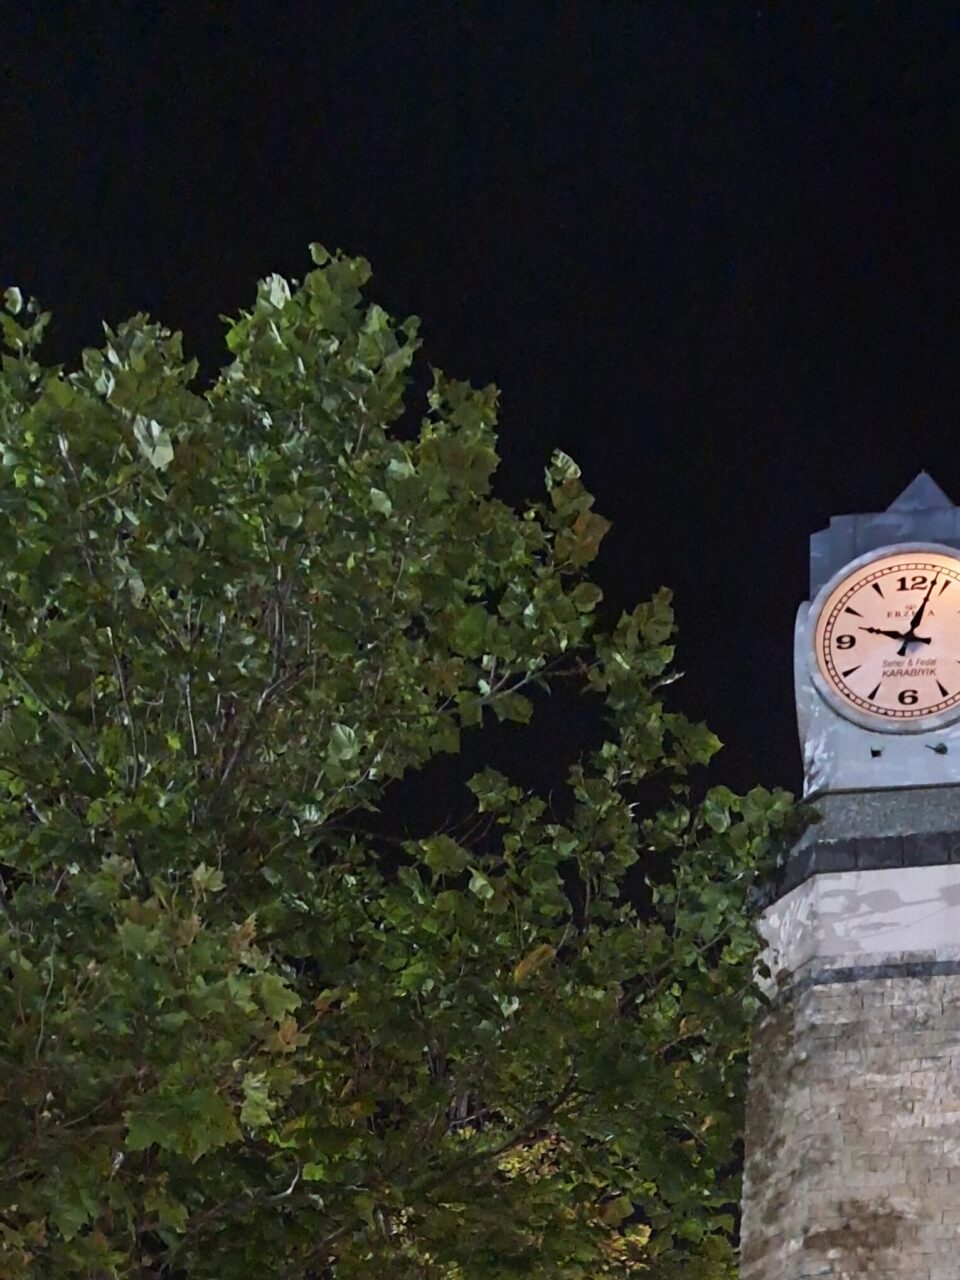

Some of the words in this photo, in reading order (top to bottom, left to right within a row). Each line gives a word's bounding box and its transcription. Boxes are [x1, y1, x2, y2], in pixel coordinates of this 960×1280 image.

[896, 576, 929, 591] 12
[886, 609, 935, 618] ERZA
[836, 634, 856, 650] 9
[907, 658, 913, 667] &
[898, 690, 919, 706] 6
